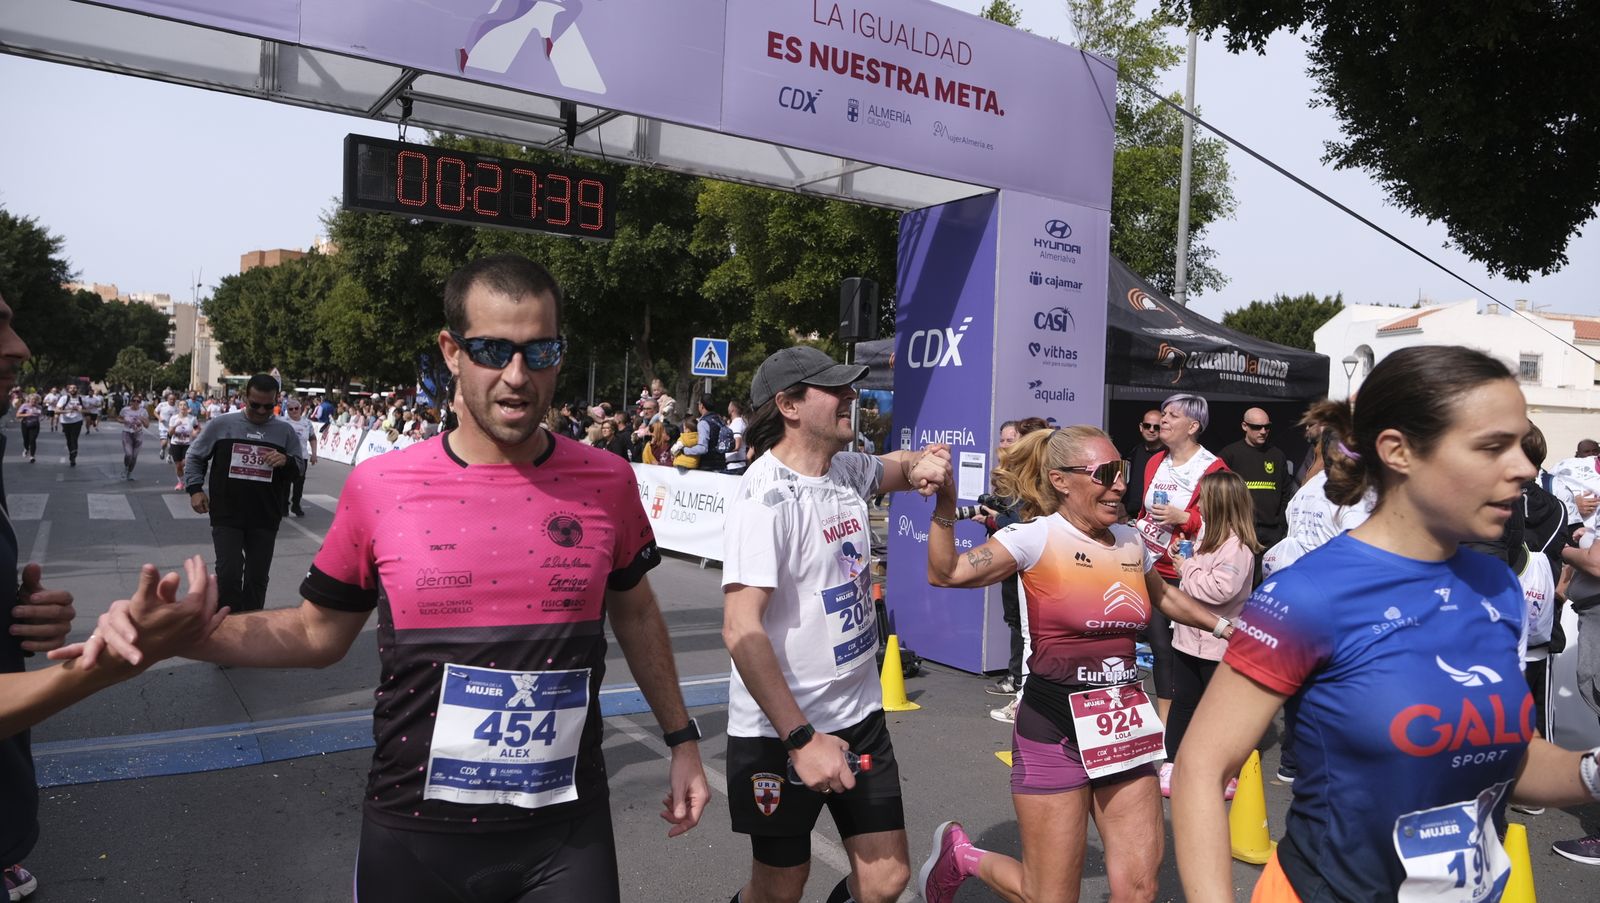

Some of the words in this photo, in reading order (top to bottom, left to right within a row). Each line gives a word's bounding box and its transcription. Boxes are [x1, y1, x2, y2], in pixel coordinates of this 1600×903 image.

[814, 0, 844, 30] LA
[852, 9, 972, 66] IGUALDAD
[767, 31, 803, 64] ES
[809, 42, 930, 98] NUESTRA
[934, 77, 1005, 117] META.
[778, 87, 822, 114] CDX
[868, 104, 912, 125] ALMERÍA
[867, 117, 891, 129] CIUDAD
[397, 150, 604, 231] 00:27:39
[1034, 238, 1081, 255] HYUNDAI
[1045, 275, 1083, 290] cajamar
[1034, 309, 1068, 333] CASI
[908, 318, 972, 369] CDX
[1044, 345, 1078, 360] vithas
[1035, 388, 1075, 404] aqualia
[920, 428, 976, 446] ALMERÍA
[242, 454, 264, 466] 938
[1154, 483, 1178, 492] MUJER
[674, 490, 724, 514] ALMERÍA
[671, 510, 697, 524] CIUDAD
[822, 518, 863, 544] MUJER
[1143, 523, 1166, 540] 627
[416, 572, 472, 587] dermal
[548, 573, 589, 588] Enrique
[835, 591, 854, 603] MUJER
[1372, 616, 1420, 635] SPIRAL
[465, 684, 503, 697] MUJER
[1083, 700, 1106, 708] MUJER
[473, 711, 557, 748] 454
[1096, 707, 1144, 736] 924
[1115, 731, 1132, 740] LOLA
[500, 748, 530, 758] ALEX
[1451, 749, 1508, 768] SPORT
[460, 766, 480, 776] CDX
[1420, 824, 1461, 839] MUJER
